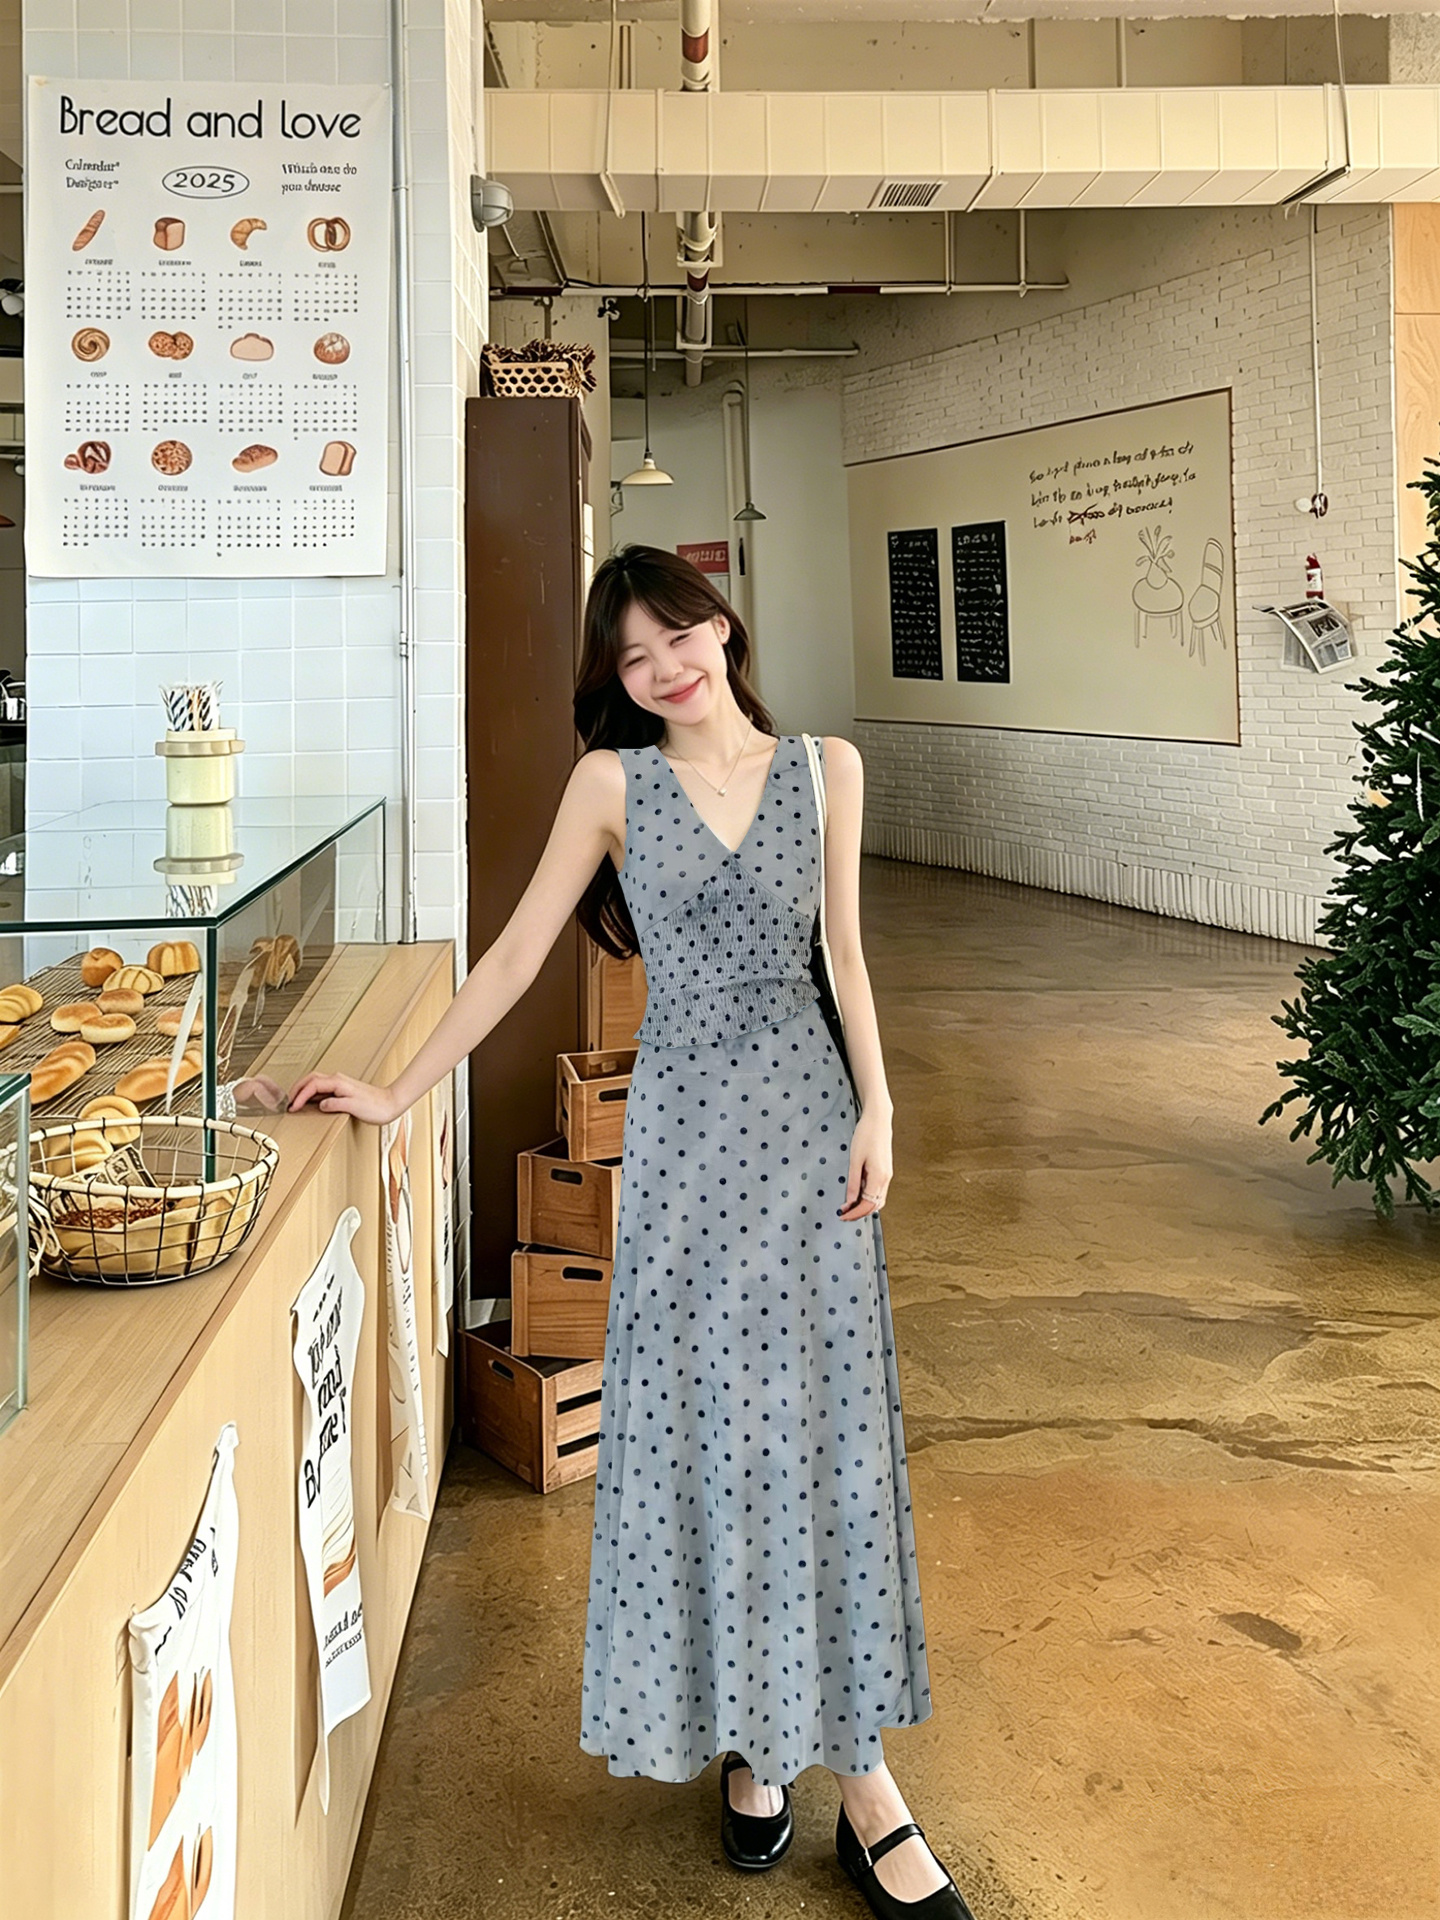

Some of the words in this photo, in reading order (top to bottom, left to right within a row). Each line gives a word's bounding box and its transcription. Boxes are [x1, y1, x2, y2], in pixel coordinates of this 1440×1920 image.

[60, 95, 171, 137] Bread
[187, 99, 262, 138] and
[281, 100, 361, 139] love
[173, 172, 236, 193] 2025
